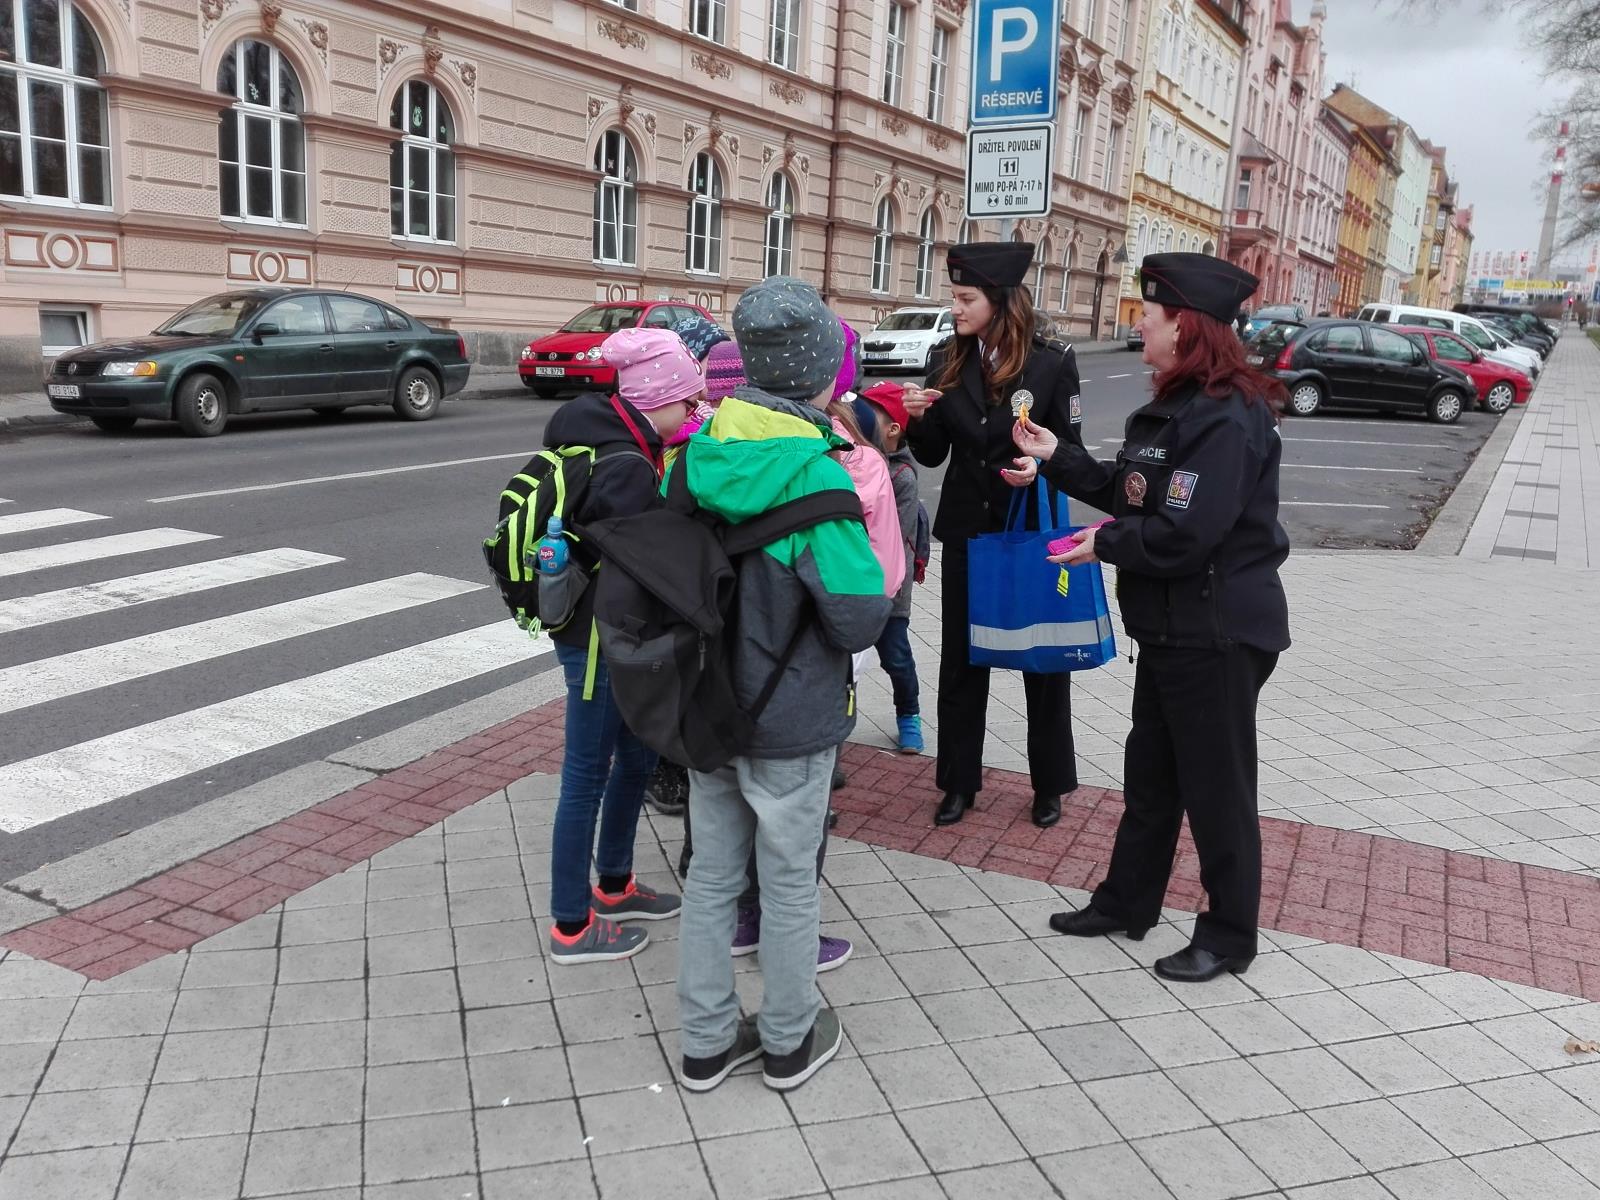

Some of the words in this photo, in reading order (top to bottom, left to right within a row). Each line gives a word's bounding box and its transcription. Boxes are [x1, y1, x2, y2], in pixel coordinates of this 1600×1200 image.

[990, 6, 1038, 82] P
[981, 88, 1043, 108] RÉSERVÉ
[978, 139, 1005, 154] DRŽITEL
[1007, 136, 1042, 152] POVOLENÍ
[1003, 160, 1016, 173] 11
[974, 181, 994, 193] MIMO
[996, 178, 1018, 192] PO-PÁ
[1037, 179, 1042, 191] h
[1004, 195, 1013, 206] 60
[1015, 195, 1028, 205] min
